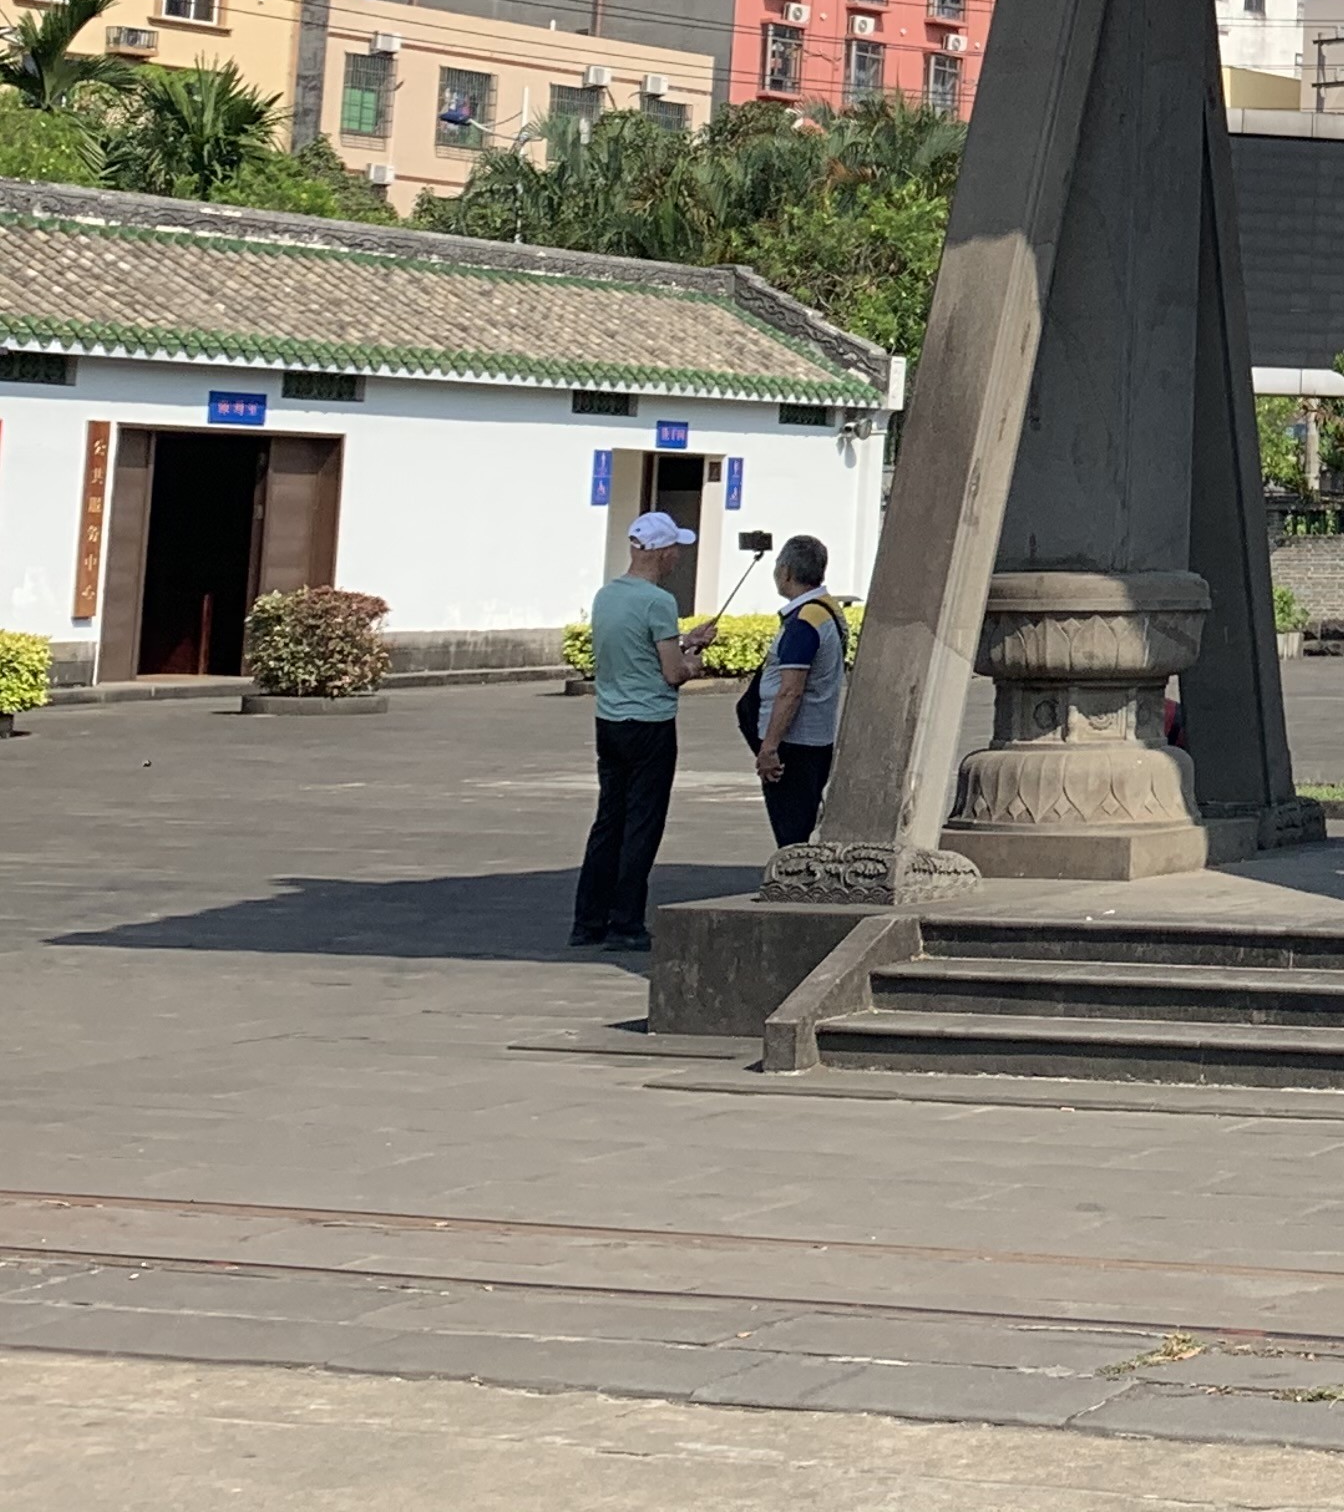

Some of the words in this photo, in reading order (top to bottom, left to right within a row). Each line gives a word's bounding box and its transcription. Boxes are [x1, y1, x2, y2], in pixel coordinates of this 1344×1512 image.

[81, 438, 107, 600] 公共服务中心
